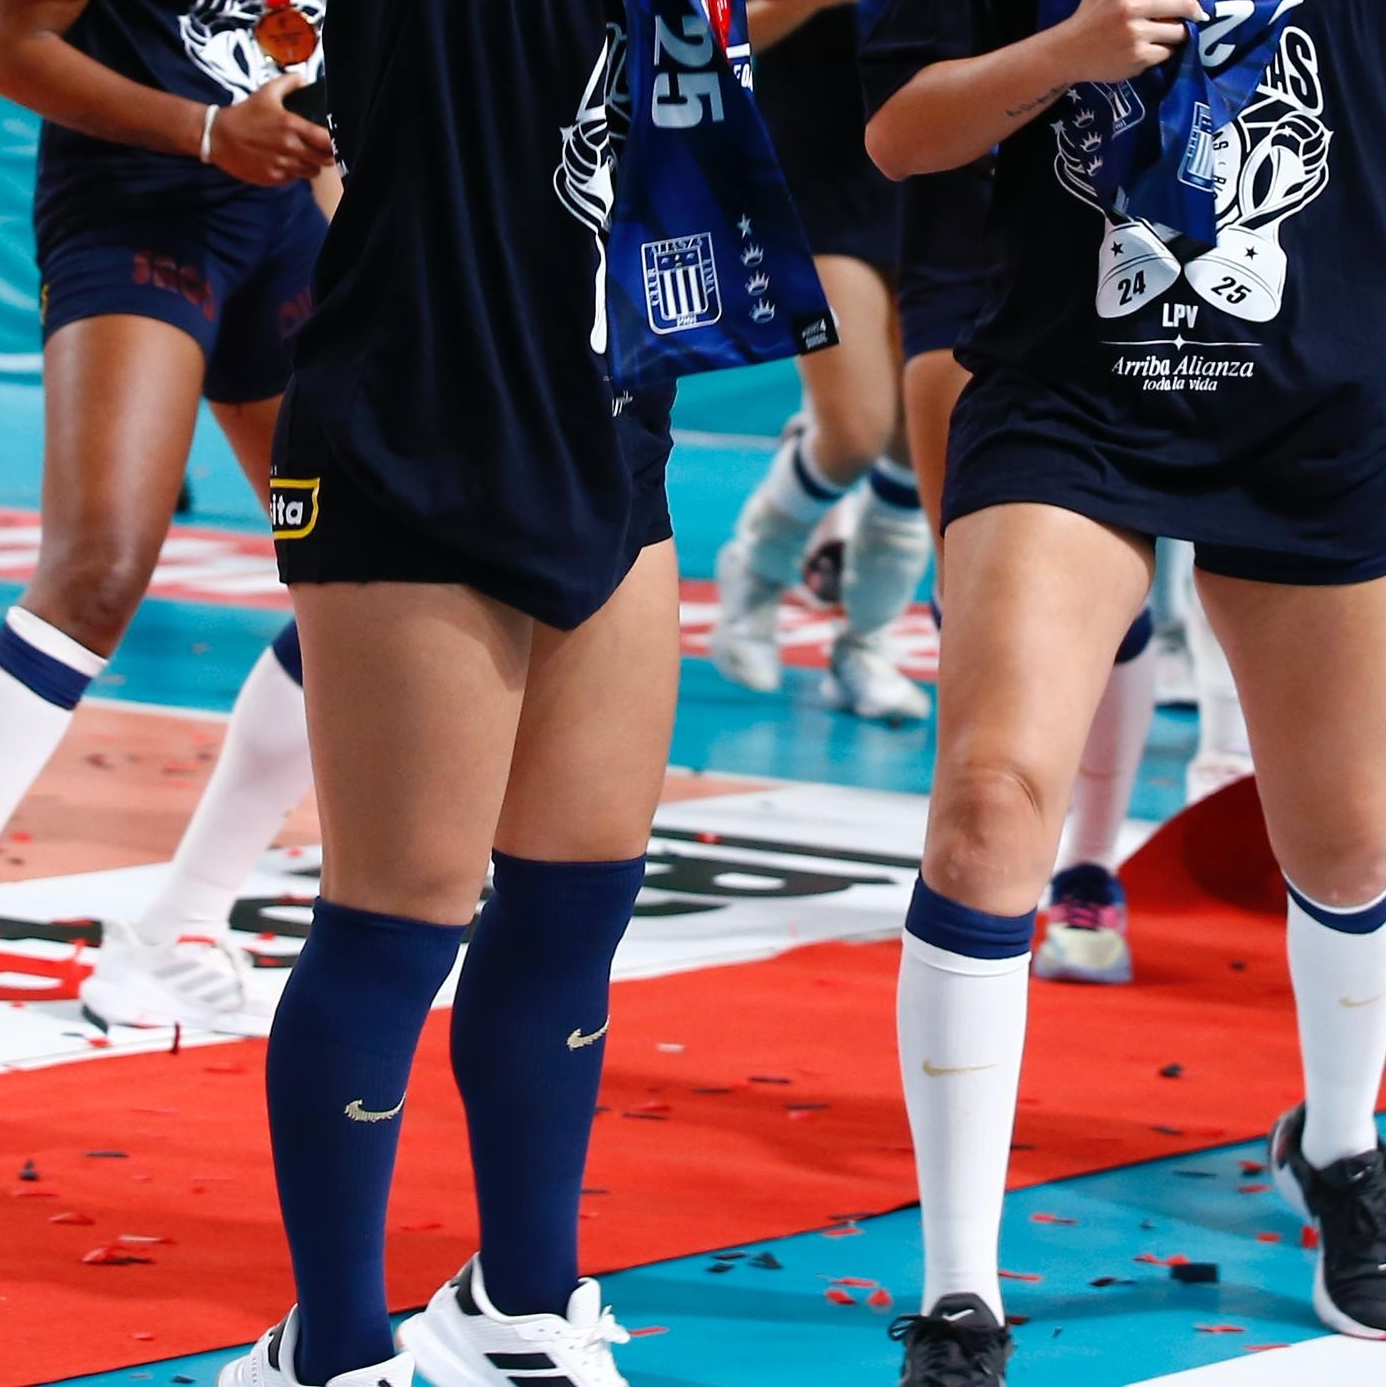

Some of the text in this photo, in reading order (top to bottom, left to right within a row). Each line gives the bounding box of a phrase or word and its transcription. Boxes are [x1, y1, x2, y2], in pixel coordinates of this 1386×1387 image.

[1117, 269, 1147, 306] 24
[1210, 276, 1253, 305] 25
[1162, 302, 1199, 329] LPV
[1112, 355, 1255, 378] Arriba Alianza
[1142, 376, 1219, 391] toda la vida
